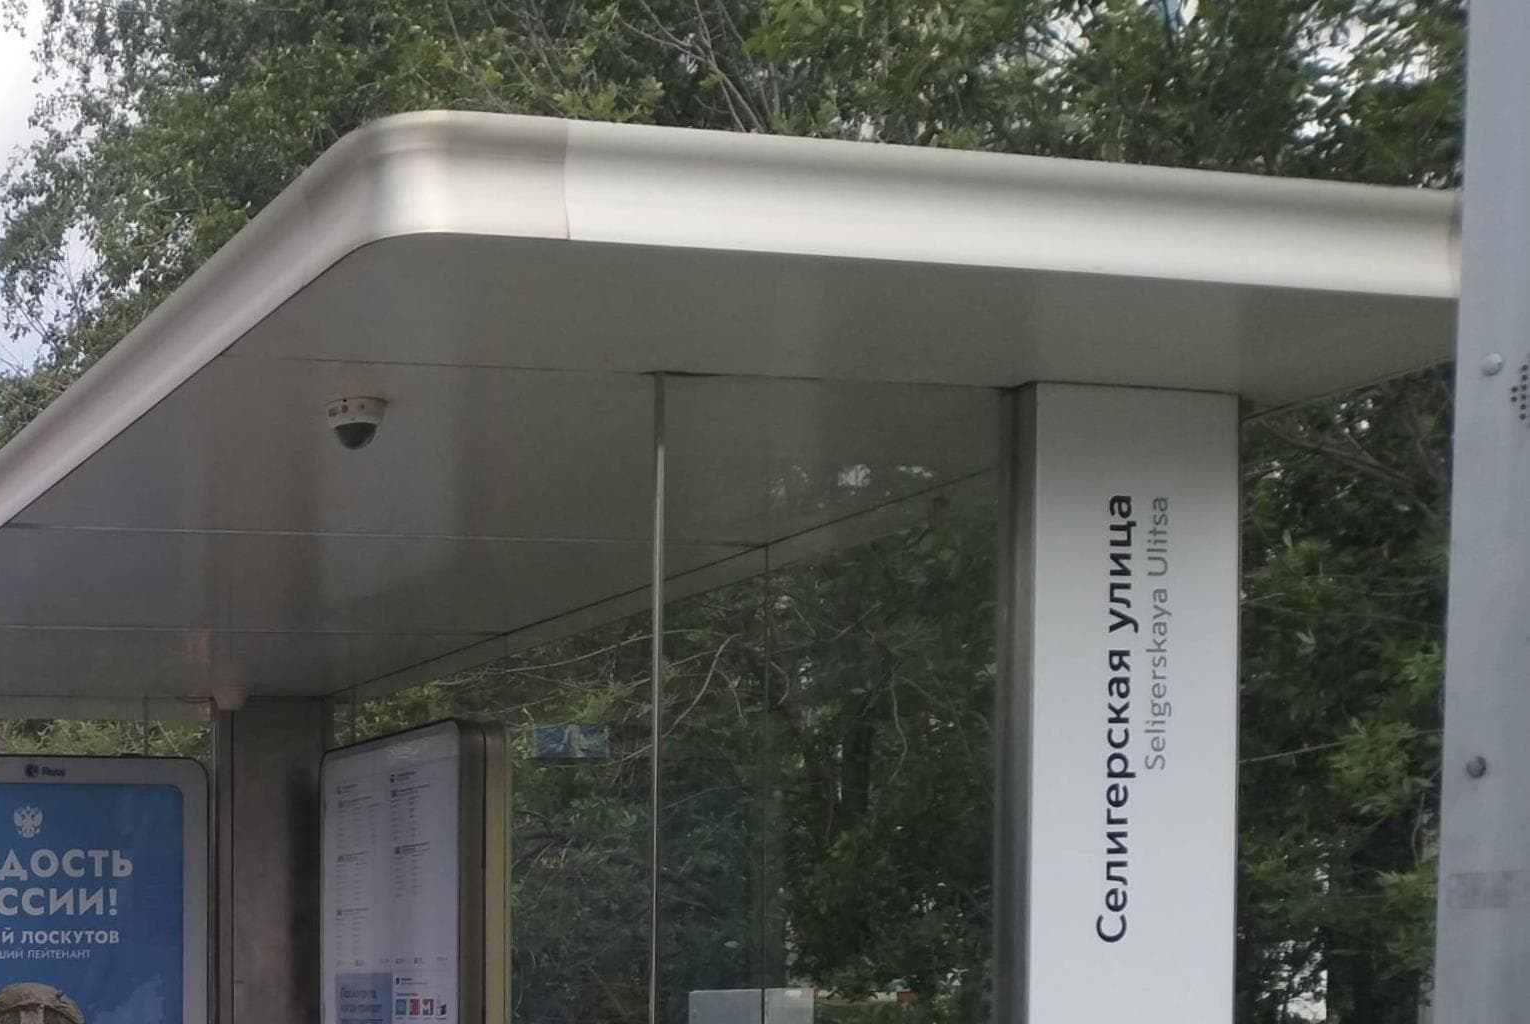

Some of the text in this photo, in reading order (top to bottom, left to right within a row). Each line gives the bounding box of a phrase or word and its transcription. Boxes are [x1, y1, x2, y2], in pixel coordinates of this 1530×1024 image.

[1145, 496, 1173, 771] Seligerskaya Ulitsa
[1096, 494, 1139, 944] Селигерская улица
[21, 929, 120, 945] ЛОСКУТОВ
[27, 948, 91, 960] ЛЕЙТЕНАНТ
